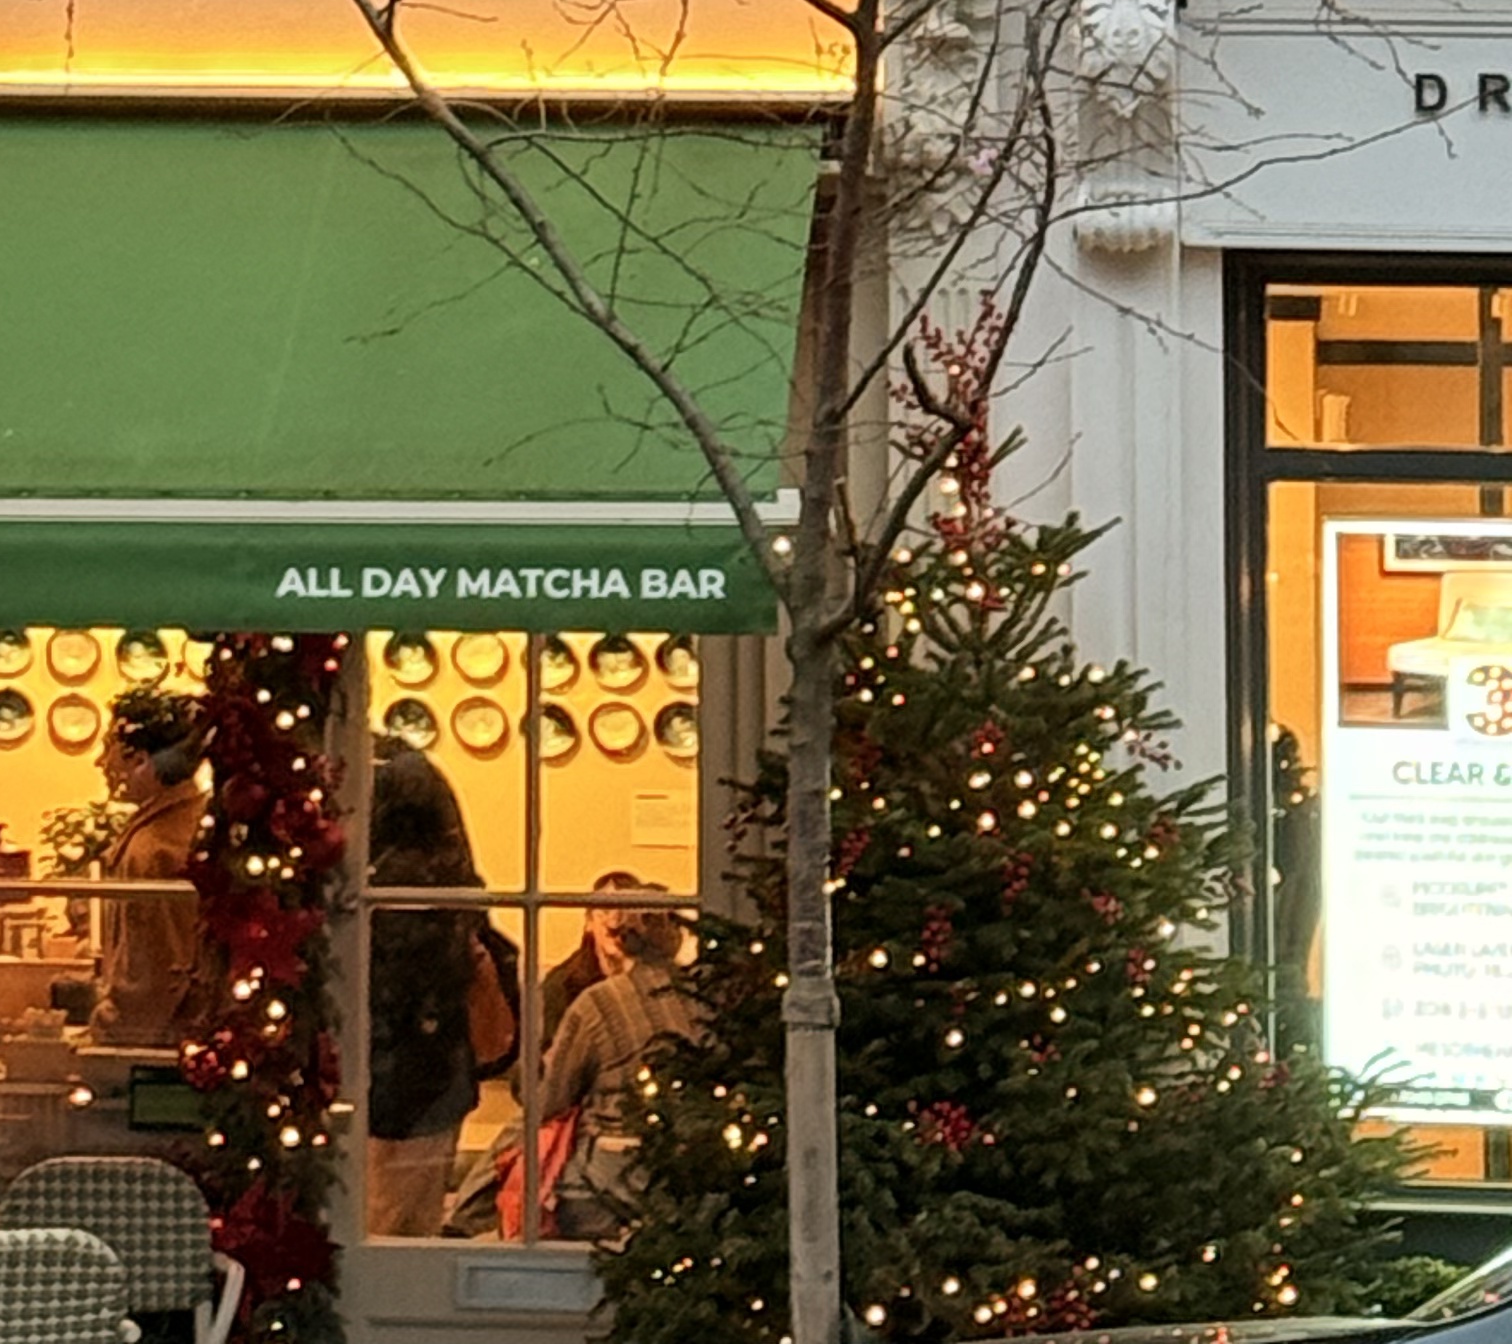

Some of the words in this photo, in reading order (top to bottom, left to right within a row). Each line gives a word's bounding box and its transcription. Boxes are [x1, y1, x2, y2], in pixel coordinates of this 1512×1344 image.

[275, 567, 354, 598] ALL
[361, 567, 448, 599] DAY
[456, 567, 631, 600] MATCHA
[639, 567, 727, 600] BAR
[1392, 760, 1485, 786] CLEAR
